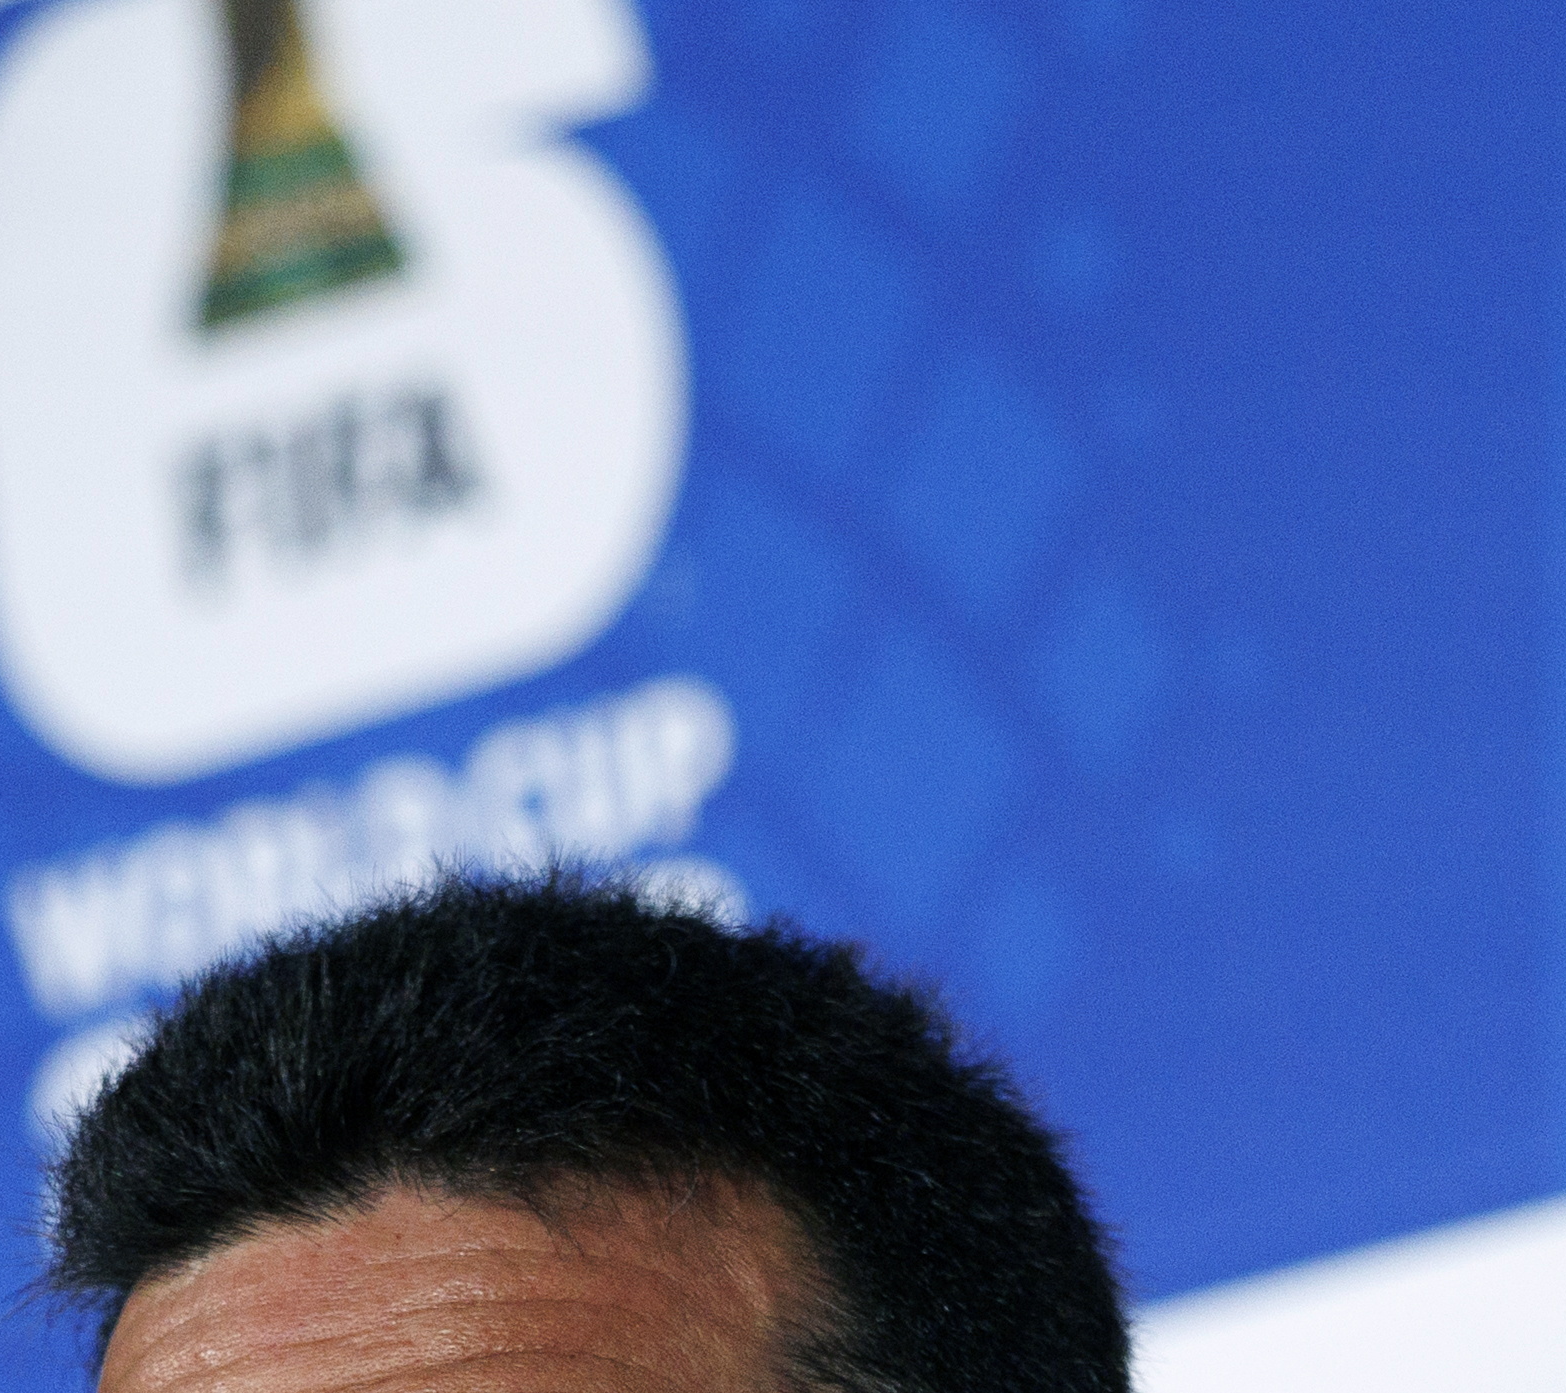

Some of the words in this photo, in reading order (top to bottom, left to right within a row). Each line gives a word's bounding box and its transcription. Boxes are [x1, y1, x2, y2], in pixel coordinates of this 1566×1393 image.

[170, 385, 490, 598] FIFA
[6, 755, 460, 1018] WORLD
[466, 675, 736, 865] CUP
